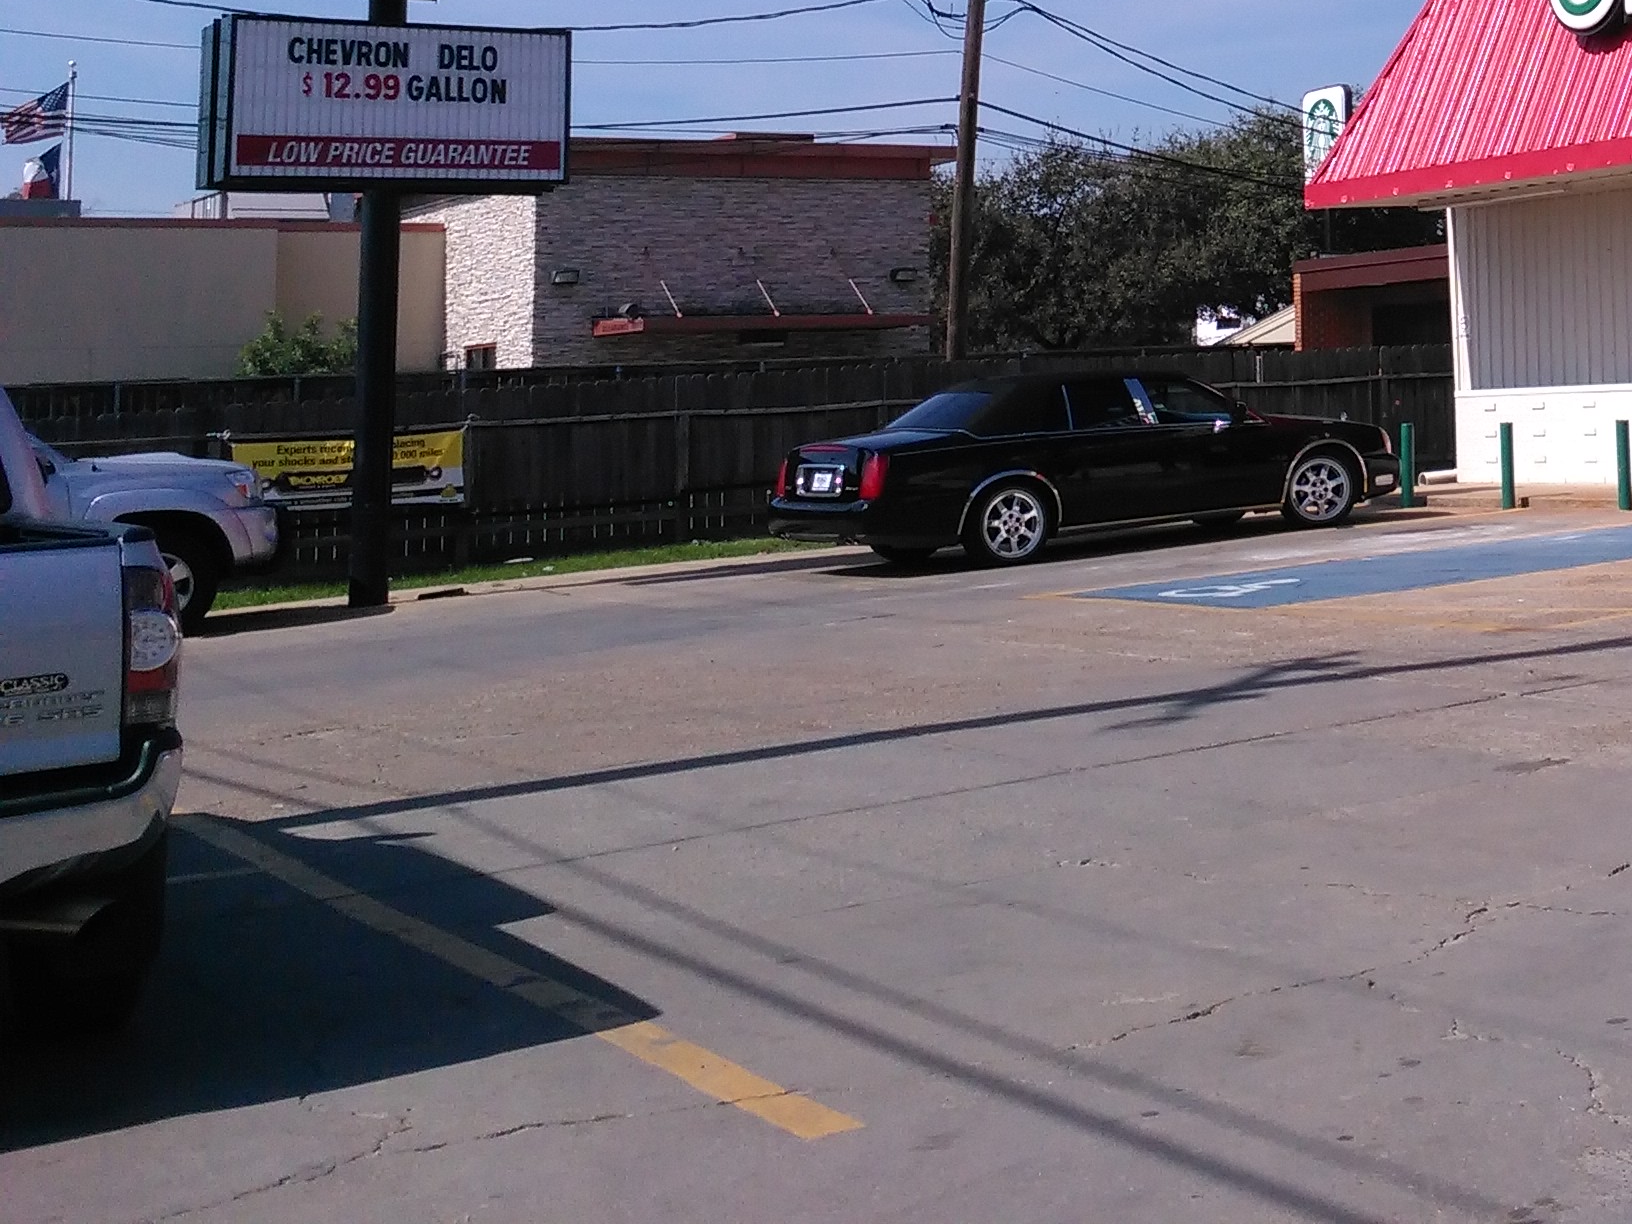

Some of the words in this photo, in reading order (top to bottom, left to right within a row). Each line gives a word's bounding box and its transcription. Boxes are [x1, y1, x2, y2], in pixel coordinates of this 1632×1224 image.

[288, 36, 409, 68] CHEVRON
[438, 43, 498, 72] DELO
[323, 72, 400, 100] 12.99
[407, 76, 507, 104] GALLON
[267, 141, 323, 163] LOW
[326, 142, 394, 164] PRICE
[401, 143, 532, 166] GUARANTEE
[252, 459, 275, 468] your
[279, 456, 315, 467] shocks
[319, 455, 338, 465] and
[276, 445, 317, 456] Experts
[0, 674, 65, 693] CLASSIC
